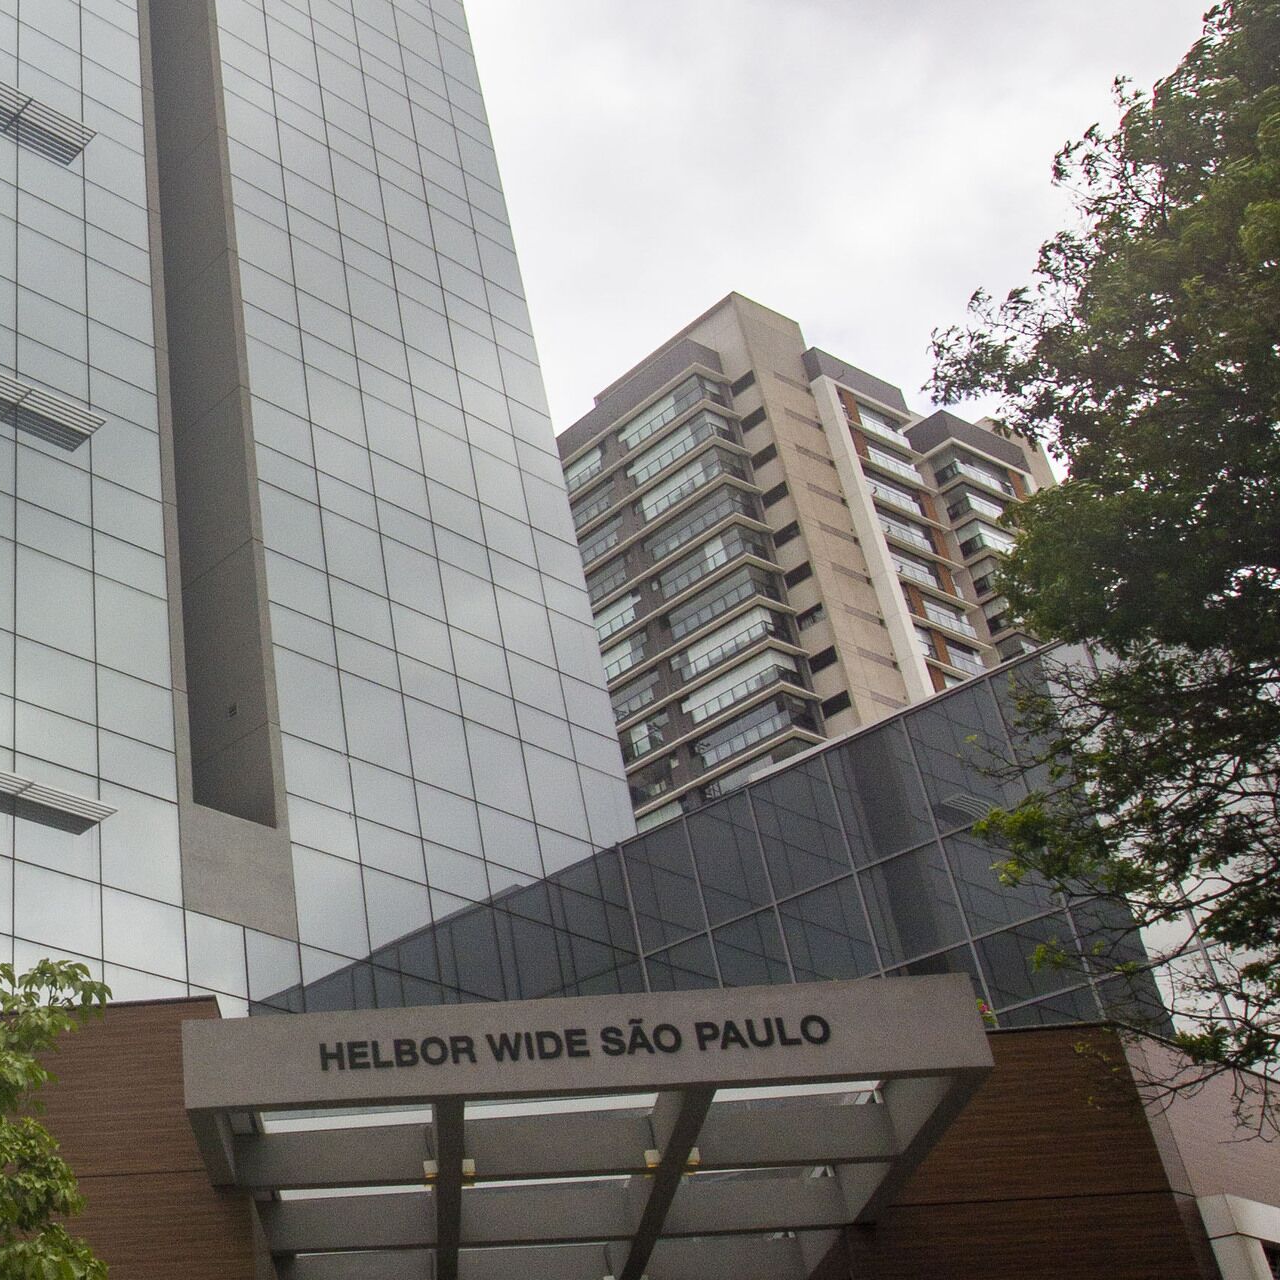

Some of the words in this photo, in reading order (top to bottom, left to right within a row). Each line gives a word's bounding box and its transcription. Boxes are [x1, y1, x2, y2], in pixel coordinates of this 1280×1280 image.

[319, 1034, 478, 1072] HELBOR
[485, 1028, 592, 1062] WIDE
[599, 1017, 683, 1056] SÃO
[695, 1014, 832, 1052] PAULO
